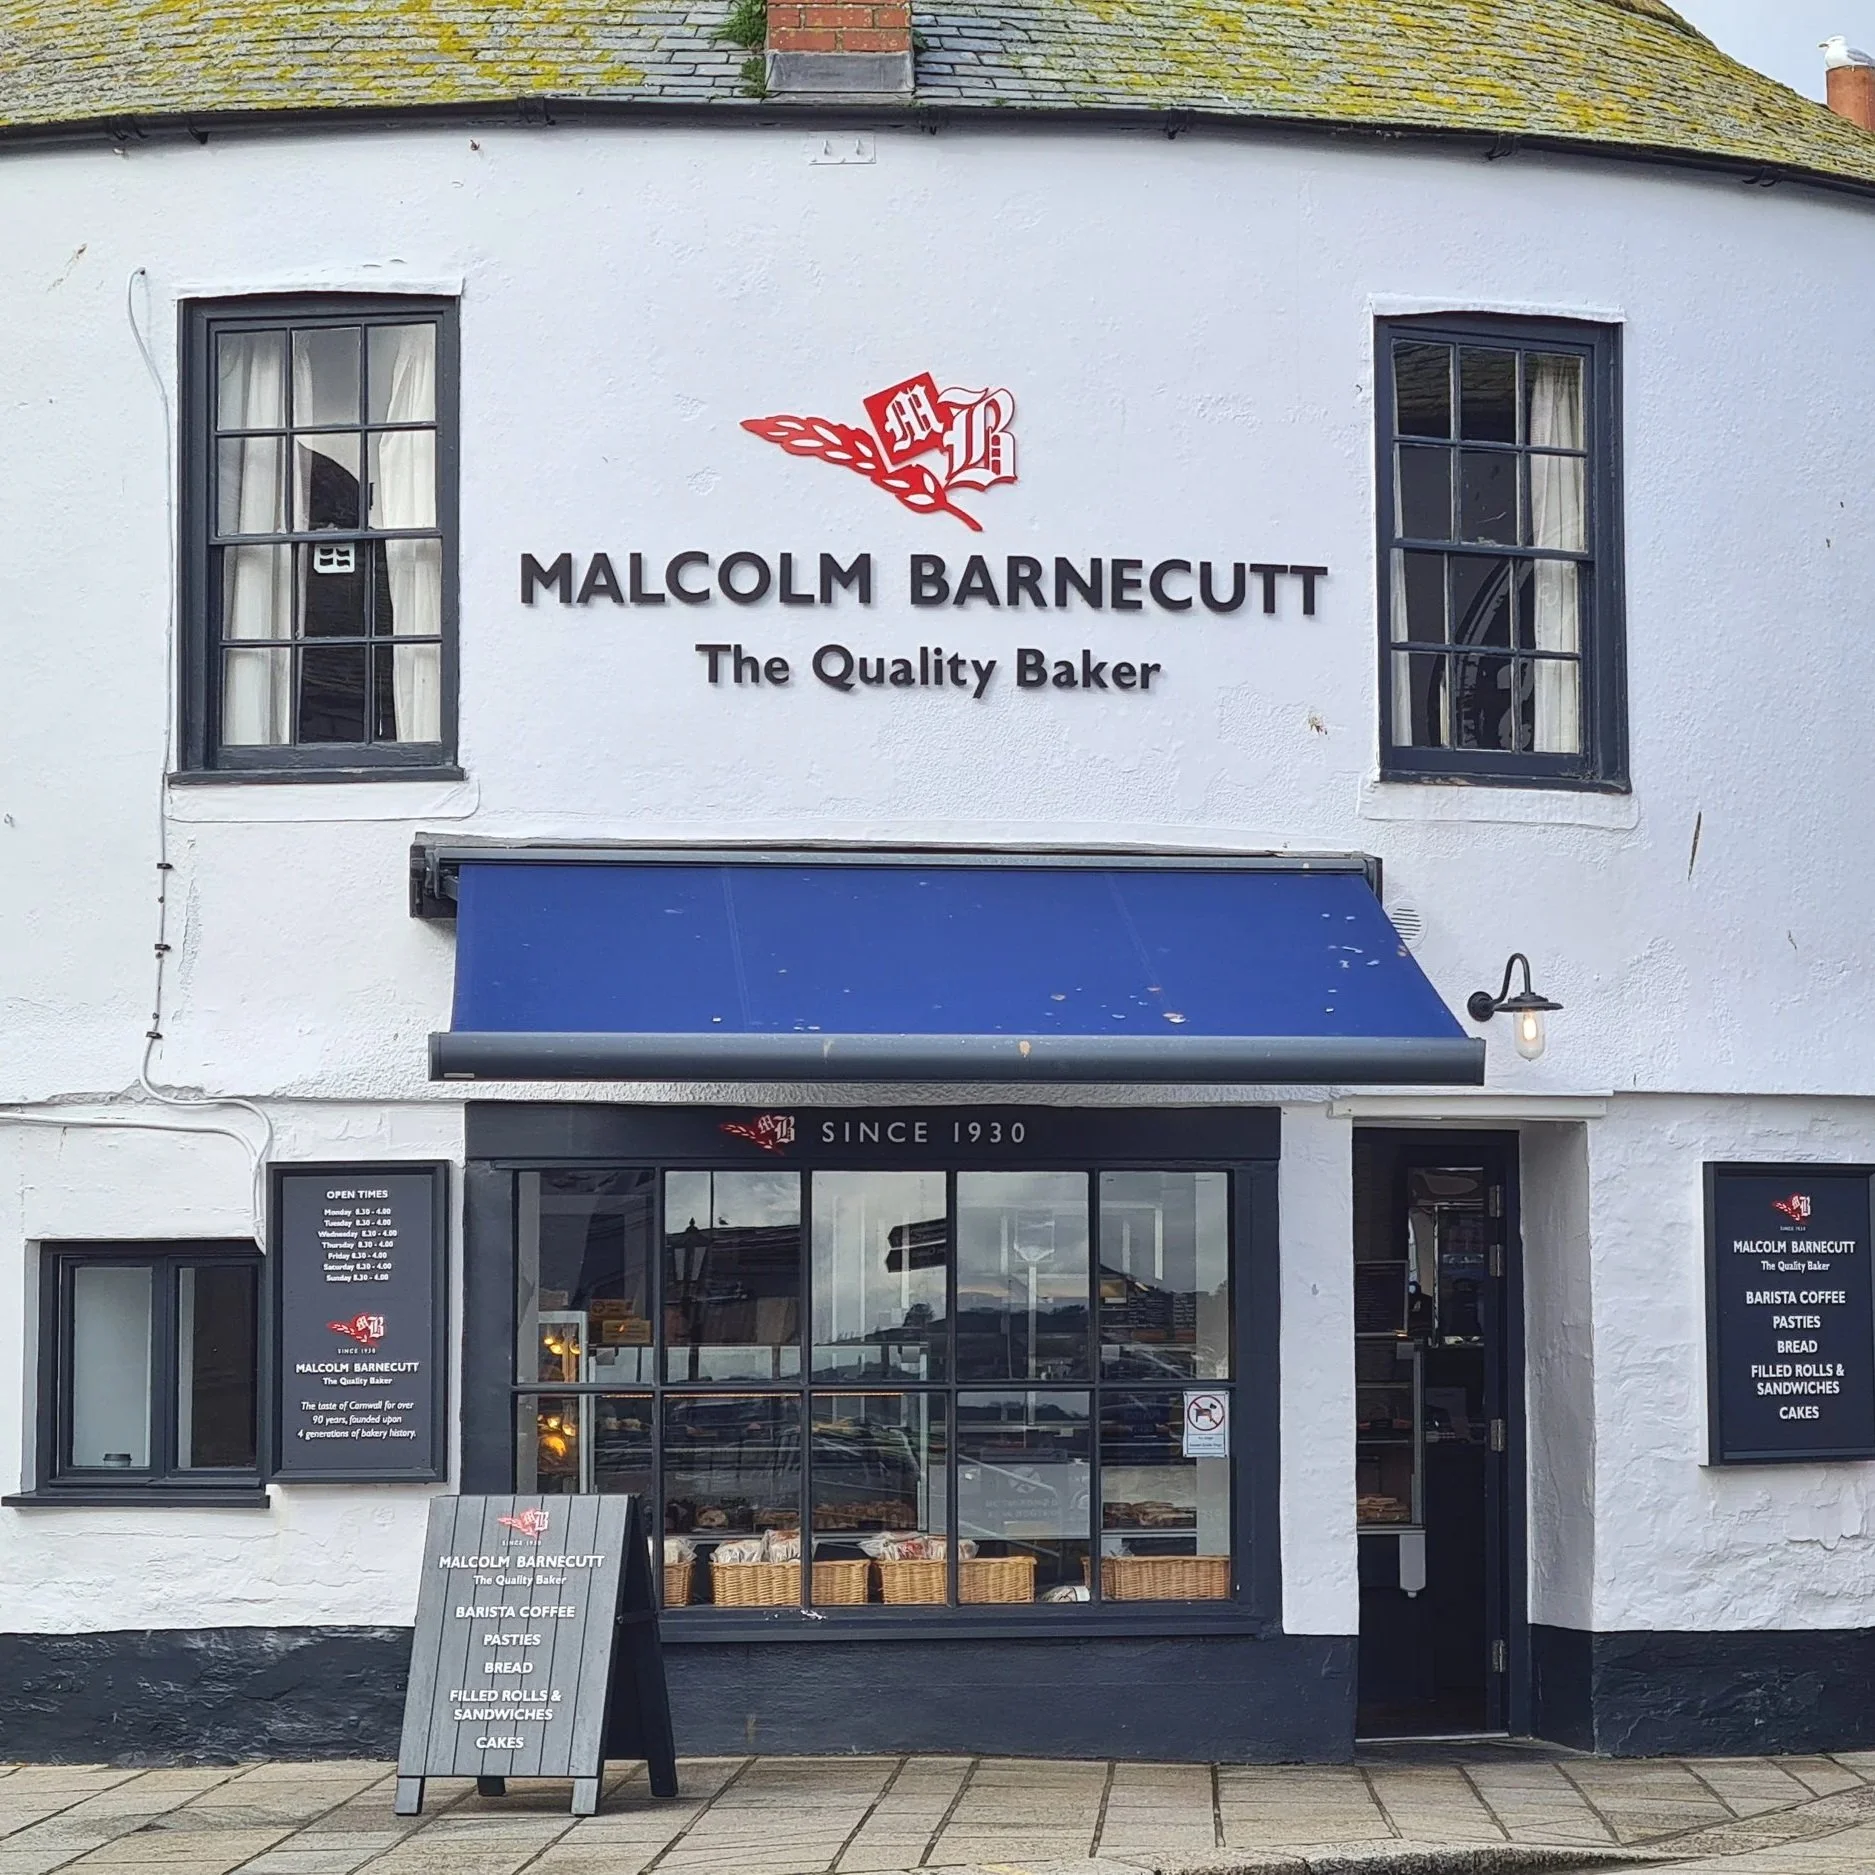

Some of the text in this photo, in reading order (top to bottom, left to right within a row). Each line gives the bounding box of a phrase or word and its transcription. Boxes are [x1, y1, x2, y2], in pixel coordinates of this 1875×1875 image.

[520, 552, 1328, 616] MALCOLM BARNECUTT
[696, 644, 1161, 698] The Quality Baker
[822, 1122, 1025, 1143] SINCE 1930
[358, 1190, 388, 1198] TIMES
[1734, 1241, 1855, 1254] MALCOLM BARNECUTT
[1761, 1261, 1829, 1272] The Quality Baker
[1746, 1291, 1845, 1304] BARISTA COFFEE
[1773, 1316, 1821, 1329] PASTIES
[1778, 1341, 1818, 1353] BREAD
[296, 1363, 419, 1373] MALCOLM BARNECUTT
[1751, 1364, 1844, 1377] FILLED ROLLS &
[340, 1377, 368, 1386] Quality
[1757, 1382, 1840, 1394] SANDWICHES
[301, 1402, 316, 1410] The
[318, 1402, 336, 1410] taste
[339, 1401, 348, 1411] of
[349, 1401, 382, 1410] Cornwall
[384, 1401, 395, 1411] for
[1780, 1406, 1819, 1419] CAKES
[313, 1415, 322, 1424] 90
[349, 1415, 380, 1425] founded
[383, 1416, 401, 1425] upon
[298, 1430, 303, 1438] 4
[306, 1430, 348, 1440] generations
[351, 1429, 360, 1439] of
[362, 1429, 387, 1439] bakery
[439, 1556, 604, 1568] MALCOLM BARNECUTT
[473, 1575, 566, 1588] The Quality Baker
[456, 1606, 575, 1618] BARISTA COFFEE
[484, 1634, 541, 1645] PASTIES
[484, 1663, 533, 1673] BREAD
[450, 1690, 561, 1701] FILLED ROLLS &
[454, 1709, 553, 1721] SANDWICHES
[476, 1737, 524, 1748] CAKES
